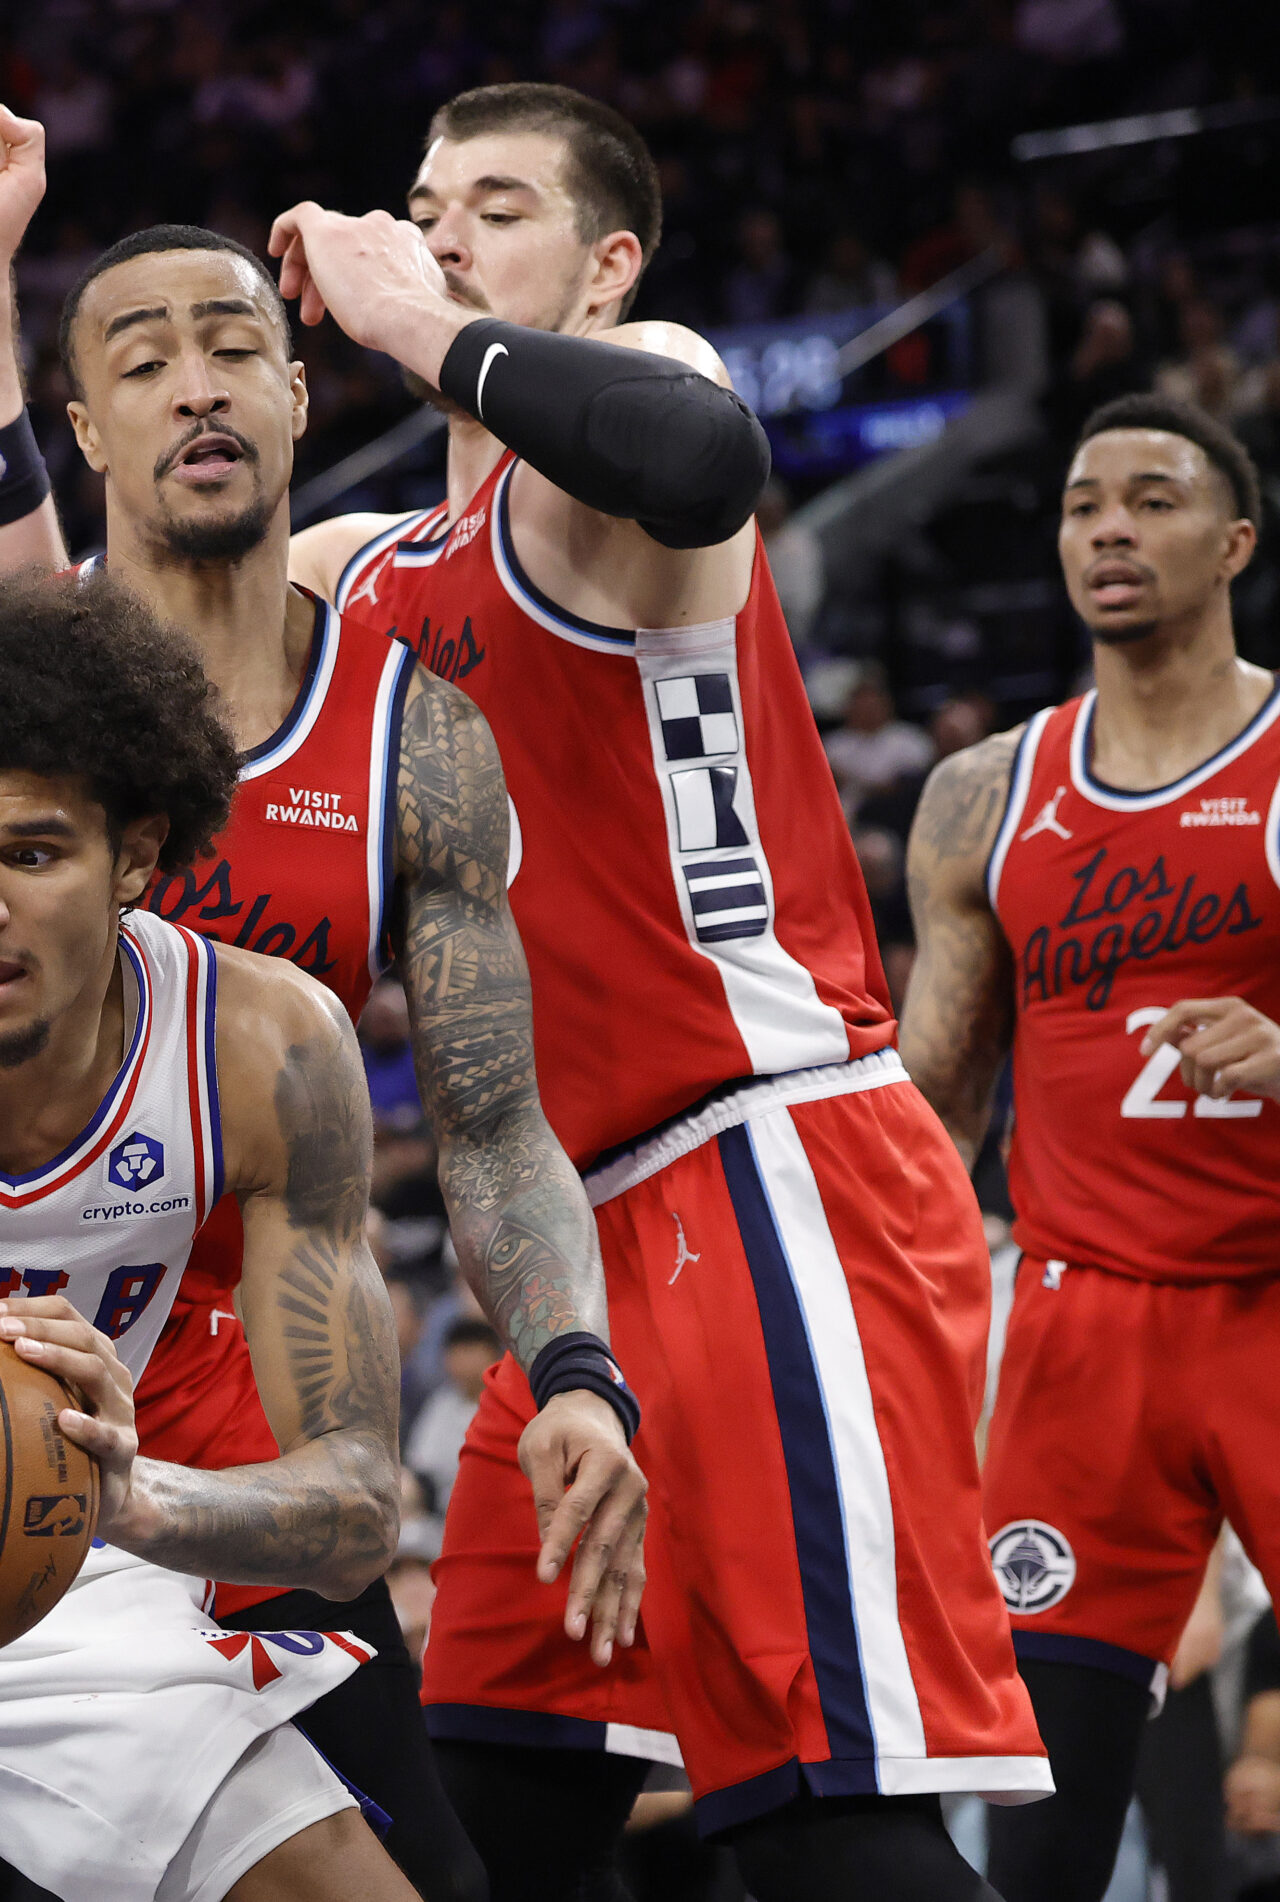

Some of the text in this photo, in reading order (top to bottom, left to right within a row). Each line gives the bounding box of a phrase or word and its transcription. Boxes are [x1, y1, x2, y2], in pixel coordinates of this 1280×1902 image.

[288, 787, 342, 811] VISIT
[1199, 797, 1248, 813] VISIT
[265, 803, 359, 832] RWANDA
[1180, 811, 1261, 828] RWANDA
[149, 858, 245, 922] os
[1059, 848, 1174, 928] Los
[1023, 876, 1263, 1013] Angeles
[82, 1197, 190, 1221] crypto.com
